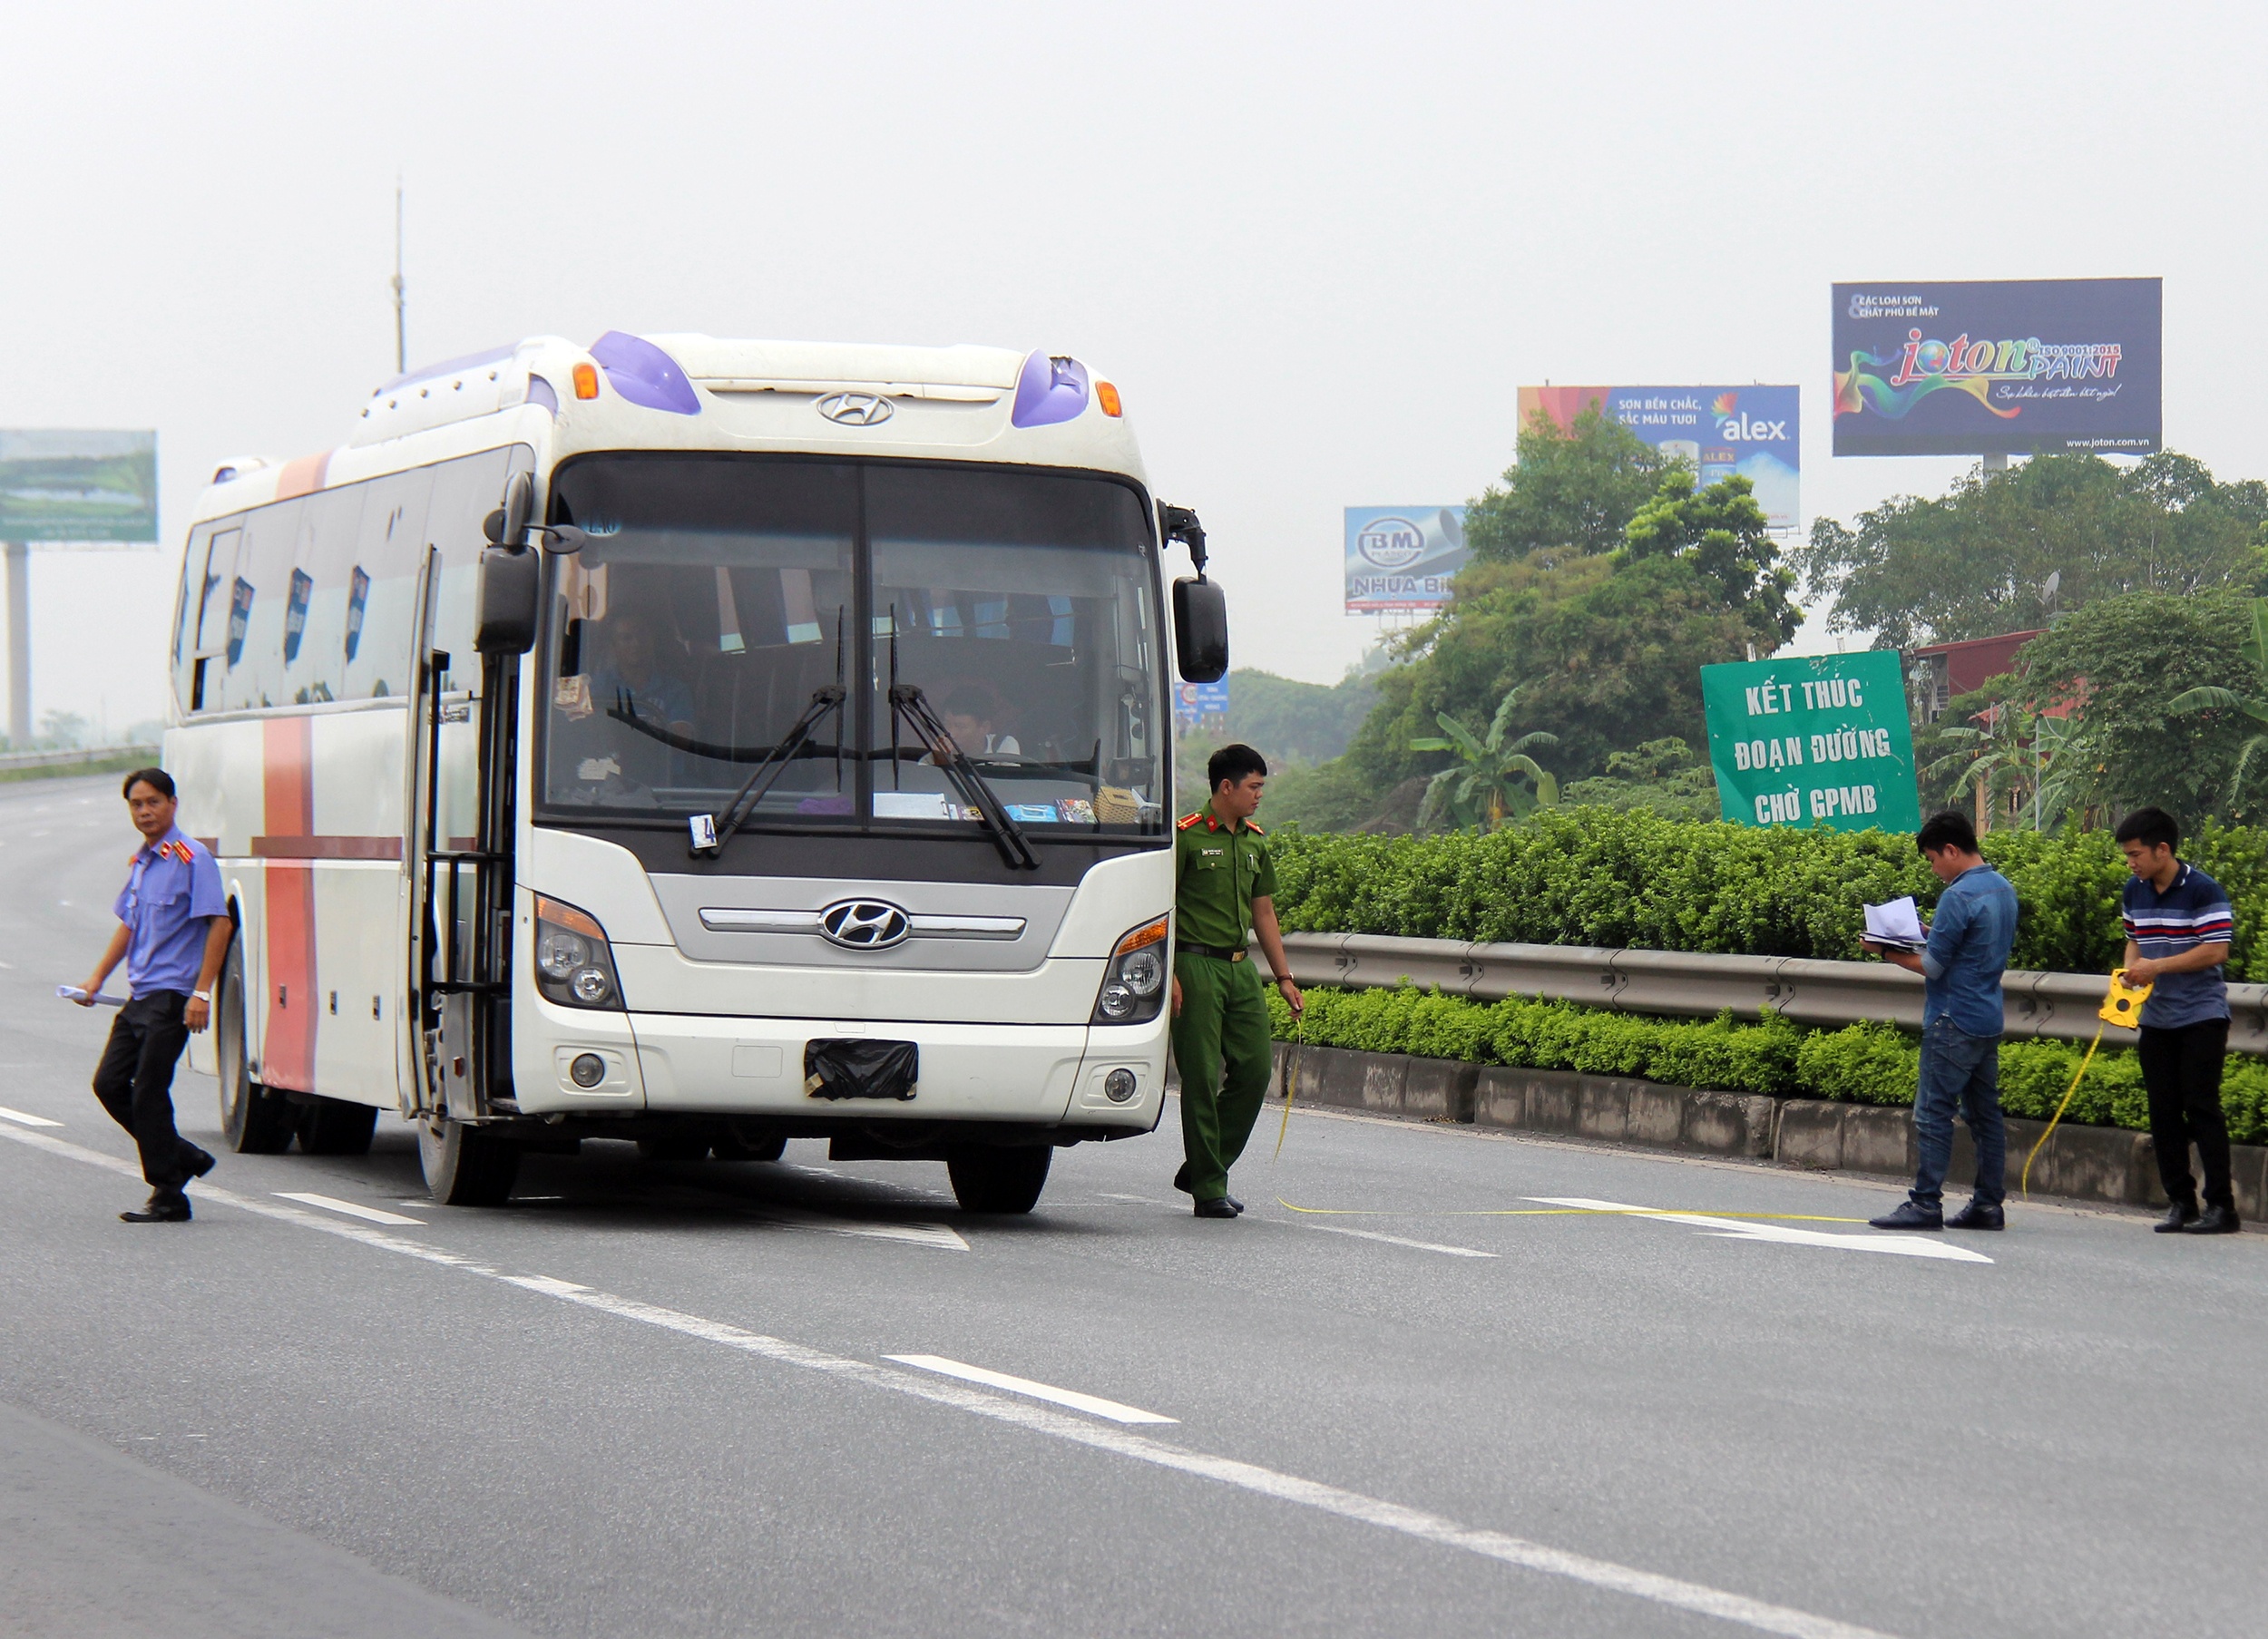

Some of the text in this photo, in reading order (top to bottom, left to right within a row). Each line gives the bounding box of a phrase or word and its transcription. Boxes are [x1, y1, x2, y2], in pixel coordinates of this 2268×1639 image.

[1859, 295, 1921, 307] CÁC LOẠI SƠN
[2039, 343, 2121, 356] ISO 9001:2015
[2028, 353, 2122, 380] PAINT
[1618, 399, 1641, 410] SƠN
[1642, 412, 1667, 424] MÀU
[1671, 414, 1696, 424] TƯƠI
[1723, 411, 1786, 442] alex
[2066, 437, 2149, 449] www.joton.com.vn
[1703, 452, 1735, 463] ALEX
[1745, 672, 1863, 716] KẾT THÚC
[1735, 723, 1892, 773] ĐOẠN ĐƯỜNG
[1755, 783, 1877, 824] CHỜ GPMB
